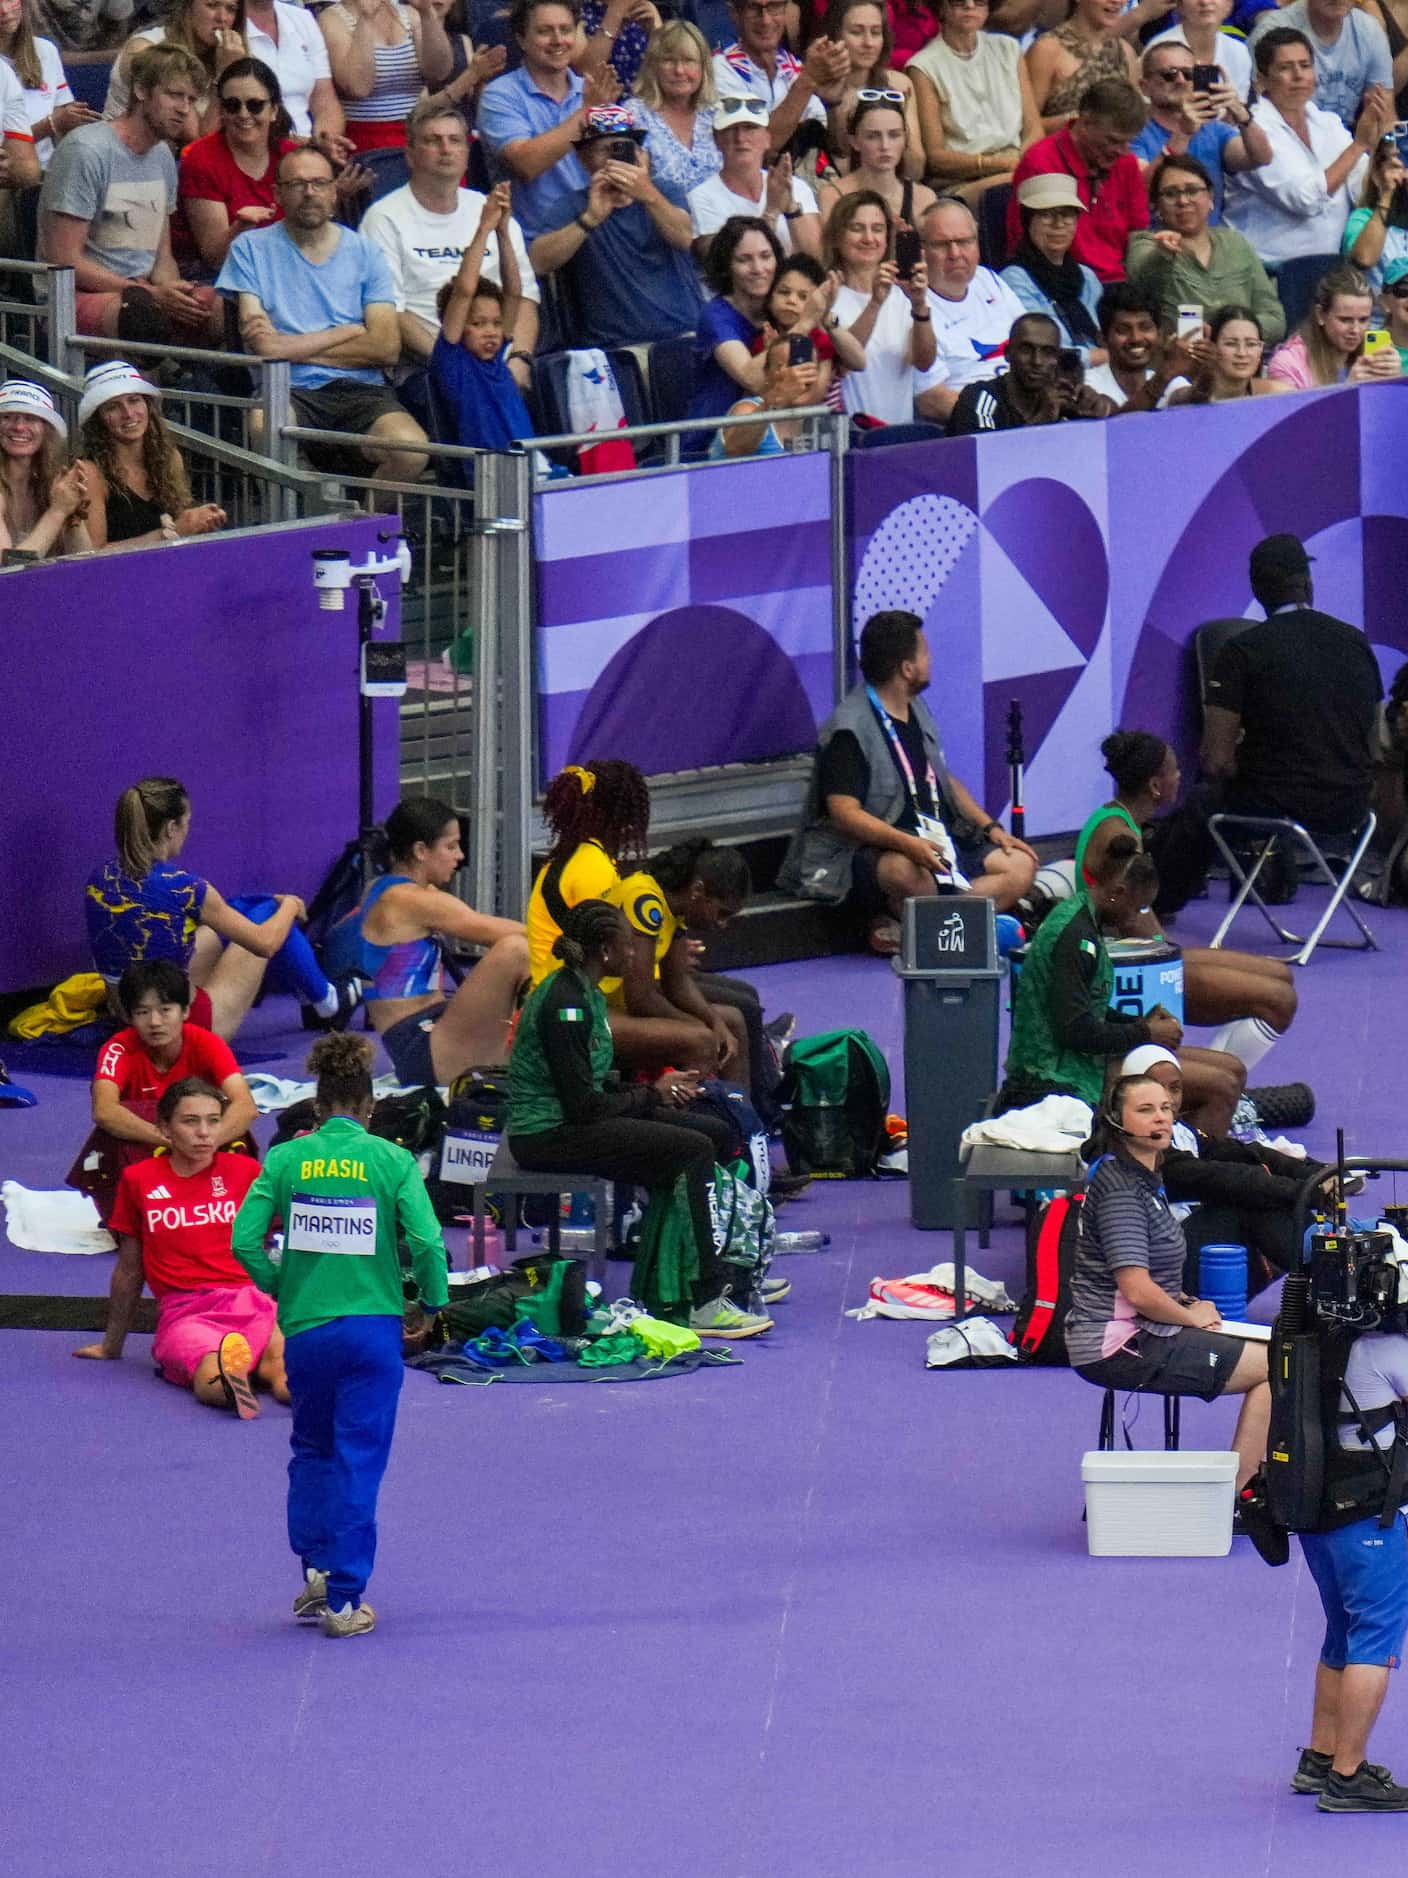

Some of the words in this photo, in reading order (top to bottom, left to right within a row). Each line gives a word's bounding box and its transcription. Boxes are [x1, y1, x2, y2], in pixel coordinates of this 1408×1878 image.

[101, 1042, 125, 1077] CHN
[301, 1159, 368, 1182] BRASIL
[147, 1201, 236, 1233] POLSKA
[293, 1213, 373, 1235] MARTINS
